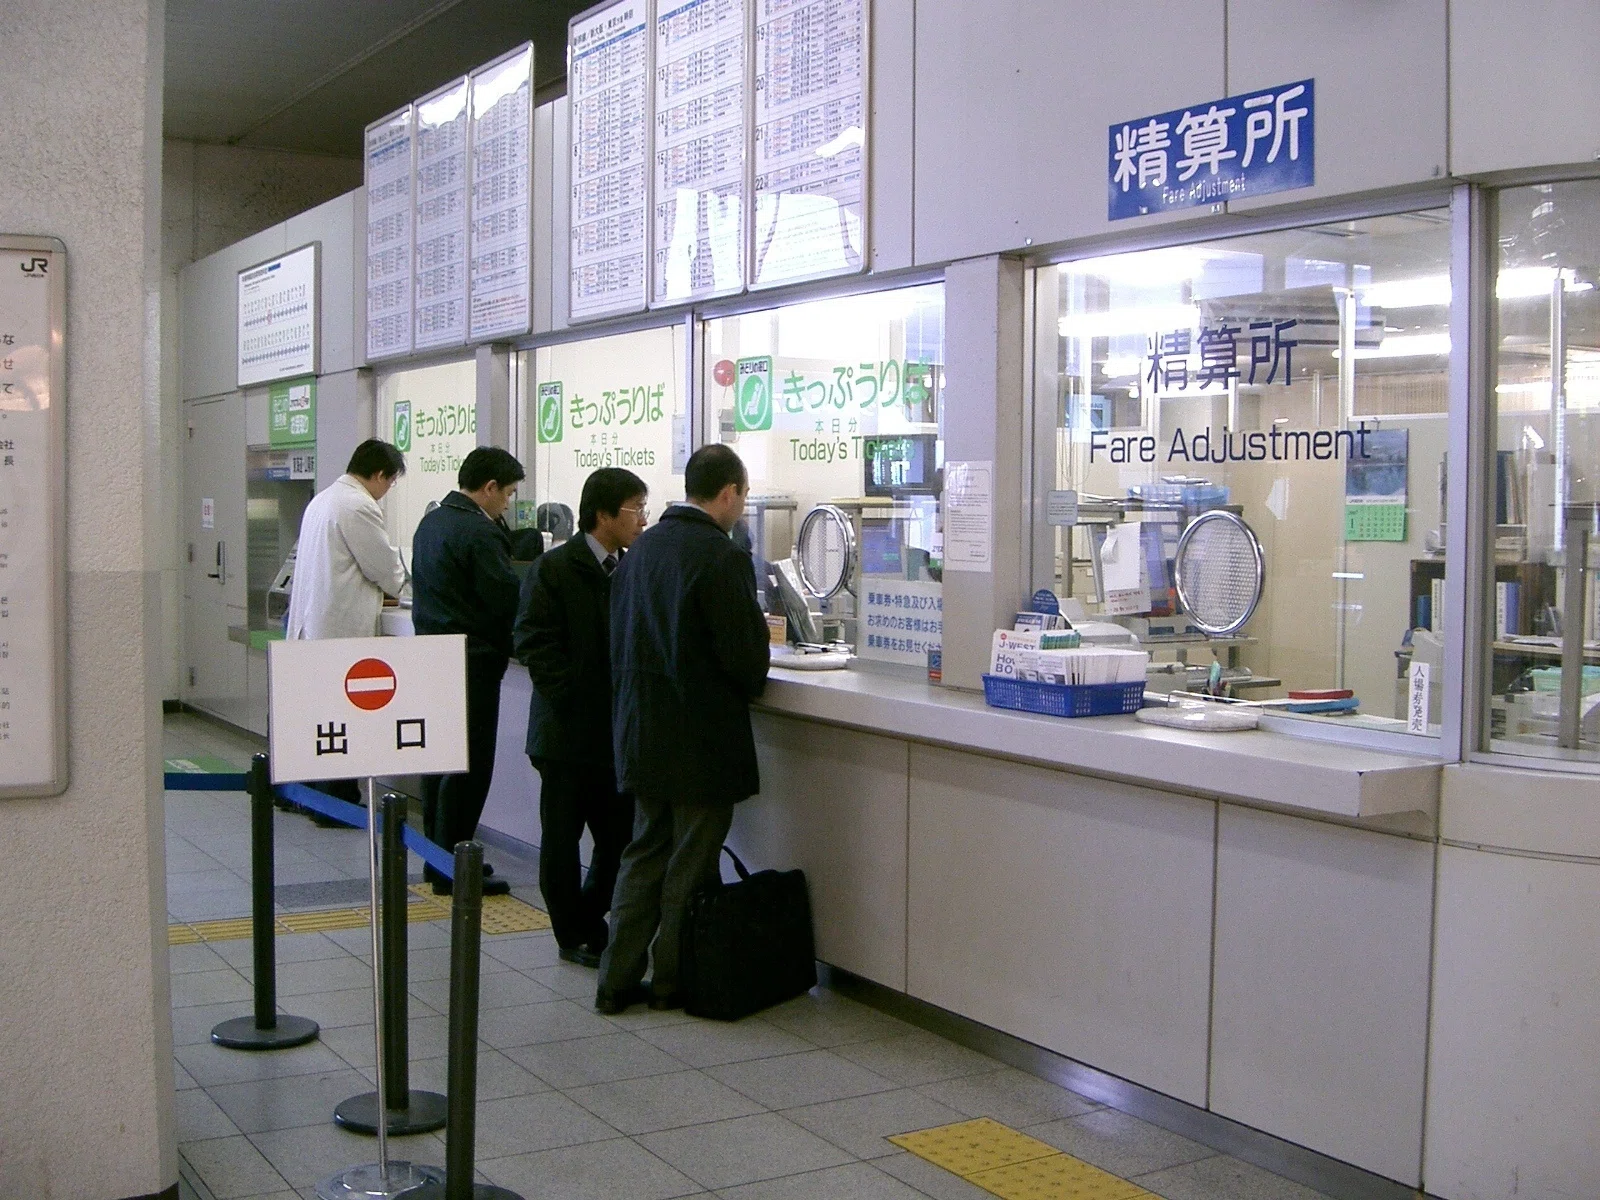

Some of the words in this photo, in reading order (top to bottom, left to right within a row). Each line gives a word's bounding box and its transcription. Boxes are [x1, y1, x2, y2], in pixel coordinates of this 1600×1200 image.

[1113, 84, 1308, 192] 精算所
[1162, 184, 1185, 205] Fare
[1188, 172, 1247, 204] Adjustment
[21, 257, 48, 273] JR
[1147, 319, 1298, 394] 精算所
[783, 357, 931, 413] きっぷうりば
[570, 382, 666, 429] きっぷうりば
[814, 417, 858, 434] 本日分
[1091, 430, 1156, 464] Fare
[1168, 421, 1371, 464] Adjustment
[574, 448, 612, 468] Today's
[613, 446, 656, 466] Tickets
[790, 437, 848, 463] Today's
[316, 718, 426, 756] 出口
